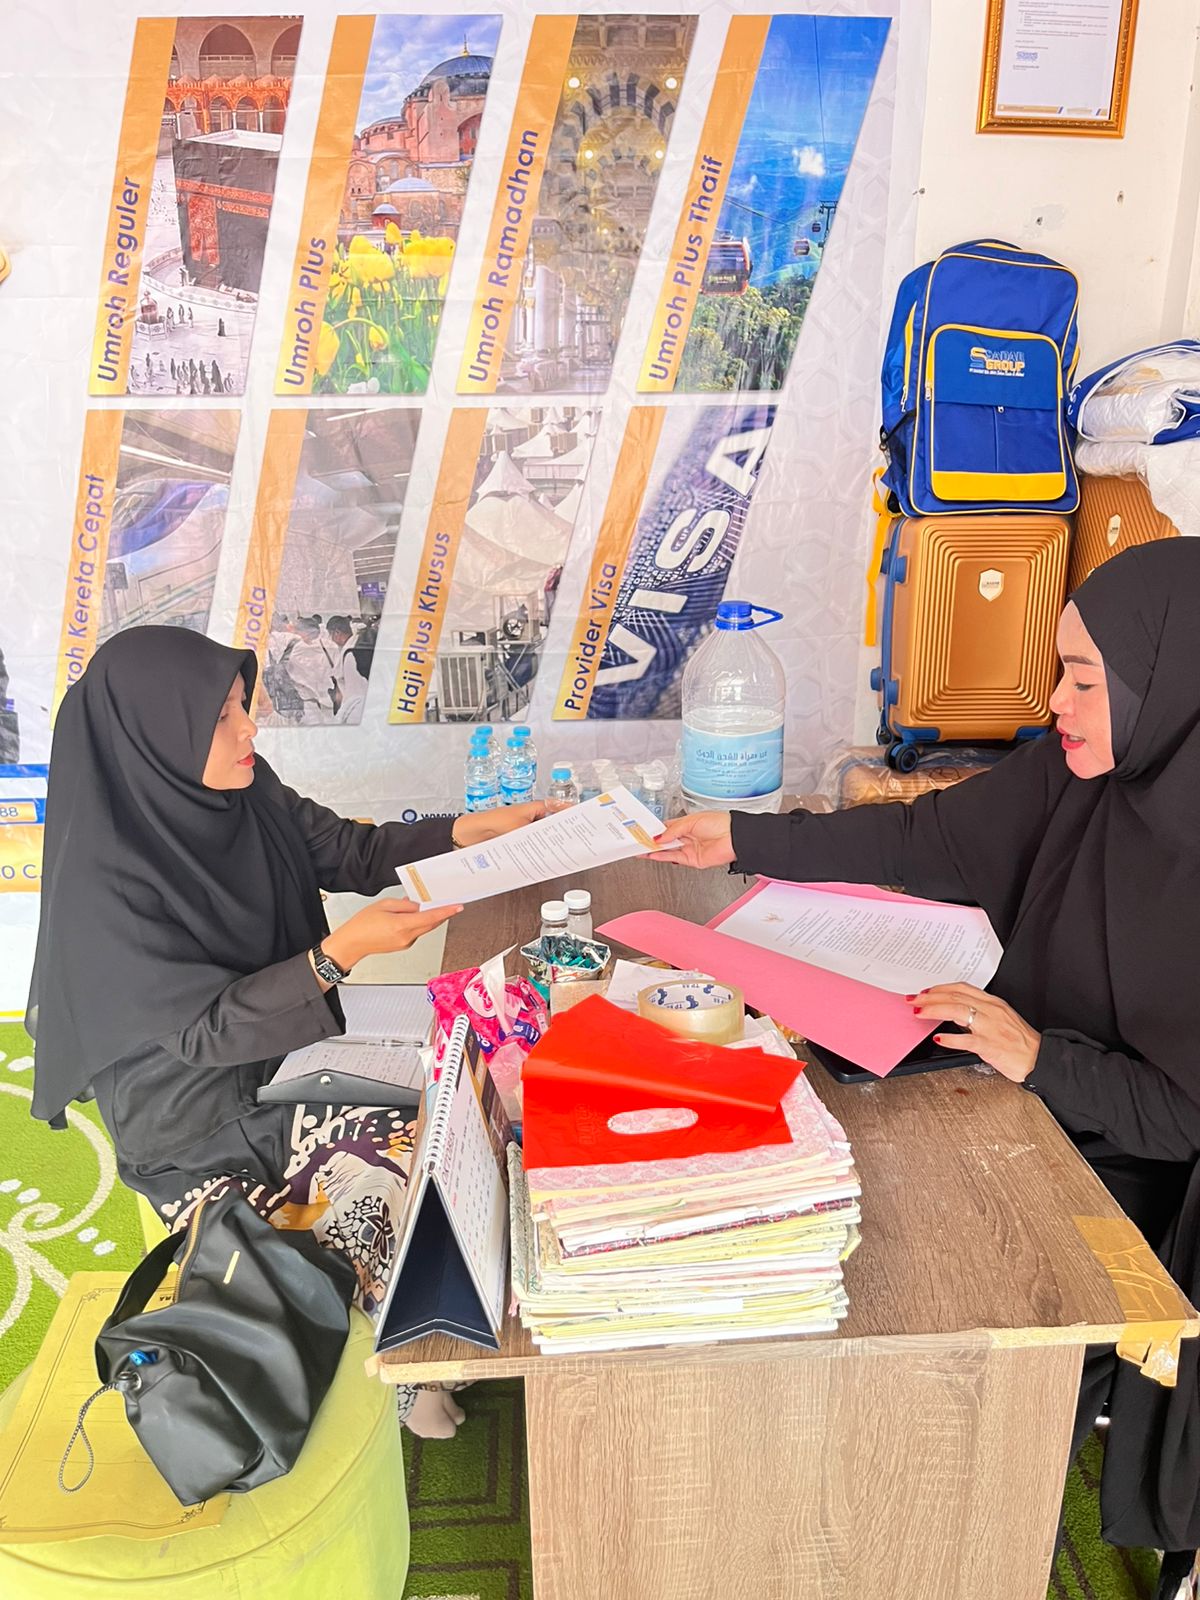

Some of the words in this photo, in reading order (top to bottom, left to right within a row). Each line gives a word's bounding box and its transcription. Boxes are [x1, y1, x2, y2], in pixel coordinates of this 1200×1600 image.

[107, 176, 141, 286] Reguler
[298, 237, 327, 291] Plus
[468, 296, 504, 382] Umroh
[488, 129, 539, 288] Ramadhan
[649, 296, 688, 381] Umroh
[673, 233, 703, 287] Plus
[688, 154, 723, 223] Thaif
[97, 295, 127, 381] Umroh
[284, 299, 317, 386] Umroh
[985, 359, 1025, 372] GROUP
[78, 473, 107, 552] Cepat
[418, 532, 450, 613] Khusus
[592, 426, 773, 687] VISA
[68, 561, 95, 639] Kereta
[244, 586, 266, 651] uroda
[564, 618, 602, 711] Provider
[589, 562, 617, 615] Visa
[65, 646, 85, 692] roh
[407, 620, 433, 664] Plus
[397, 669, 425, 714] Haji
